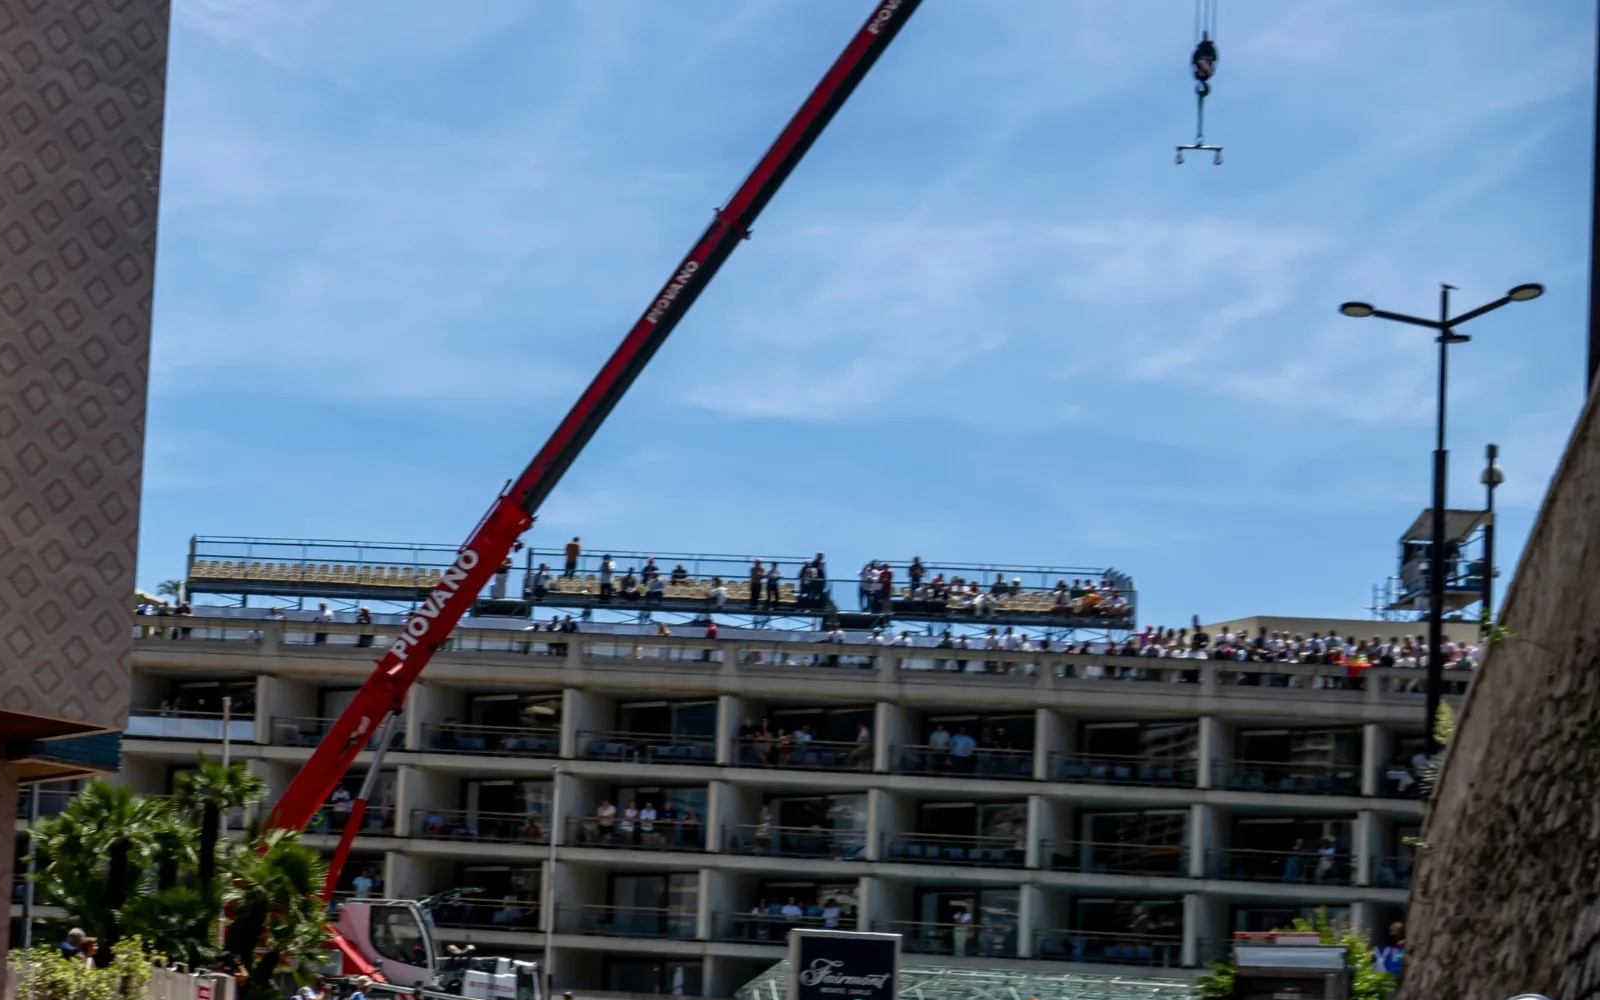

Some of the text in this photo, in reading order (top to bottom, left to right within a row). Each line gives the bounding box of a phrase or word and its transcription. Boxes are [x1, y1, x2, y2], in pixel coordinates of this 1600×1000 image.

[646, 260, 699, 324] PIOVANO
[390, 549, 480, 660] PIOVANO
[800, 958, 891, 989] Fairmont
